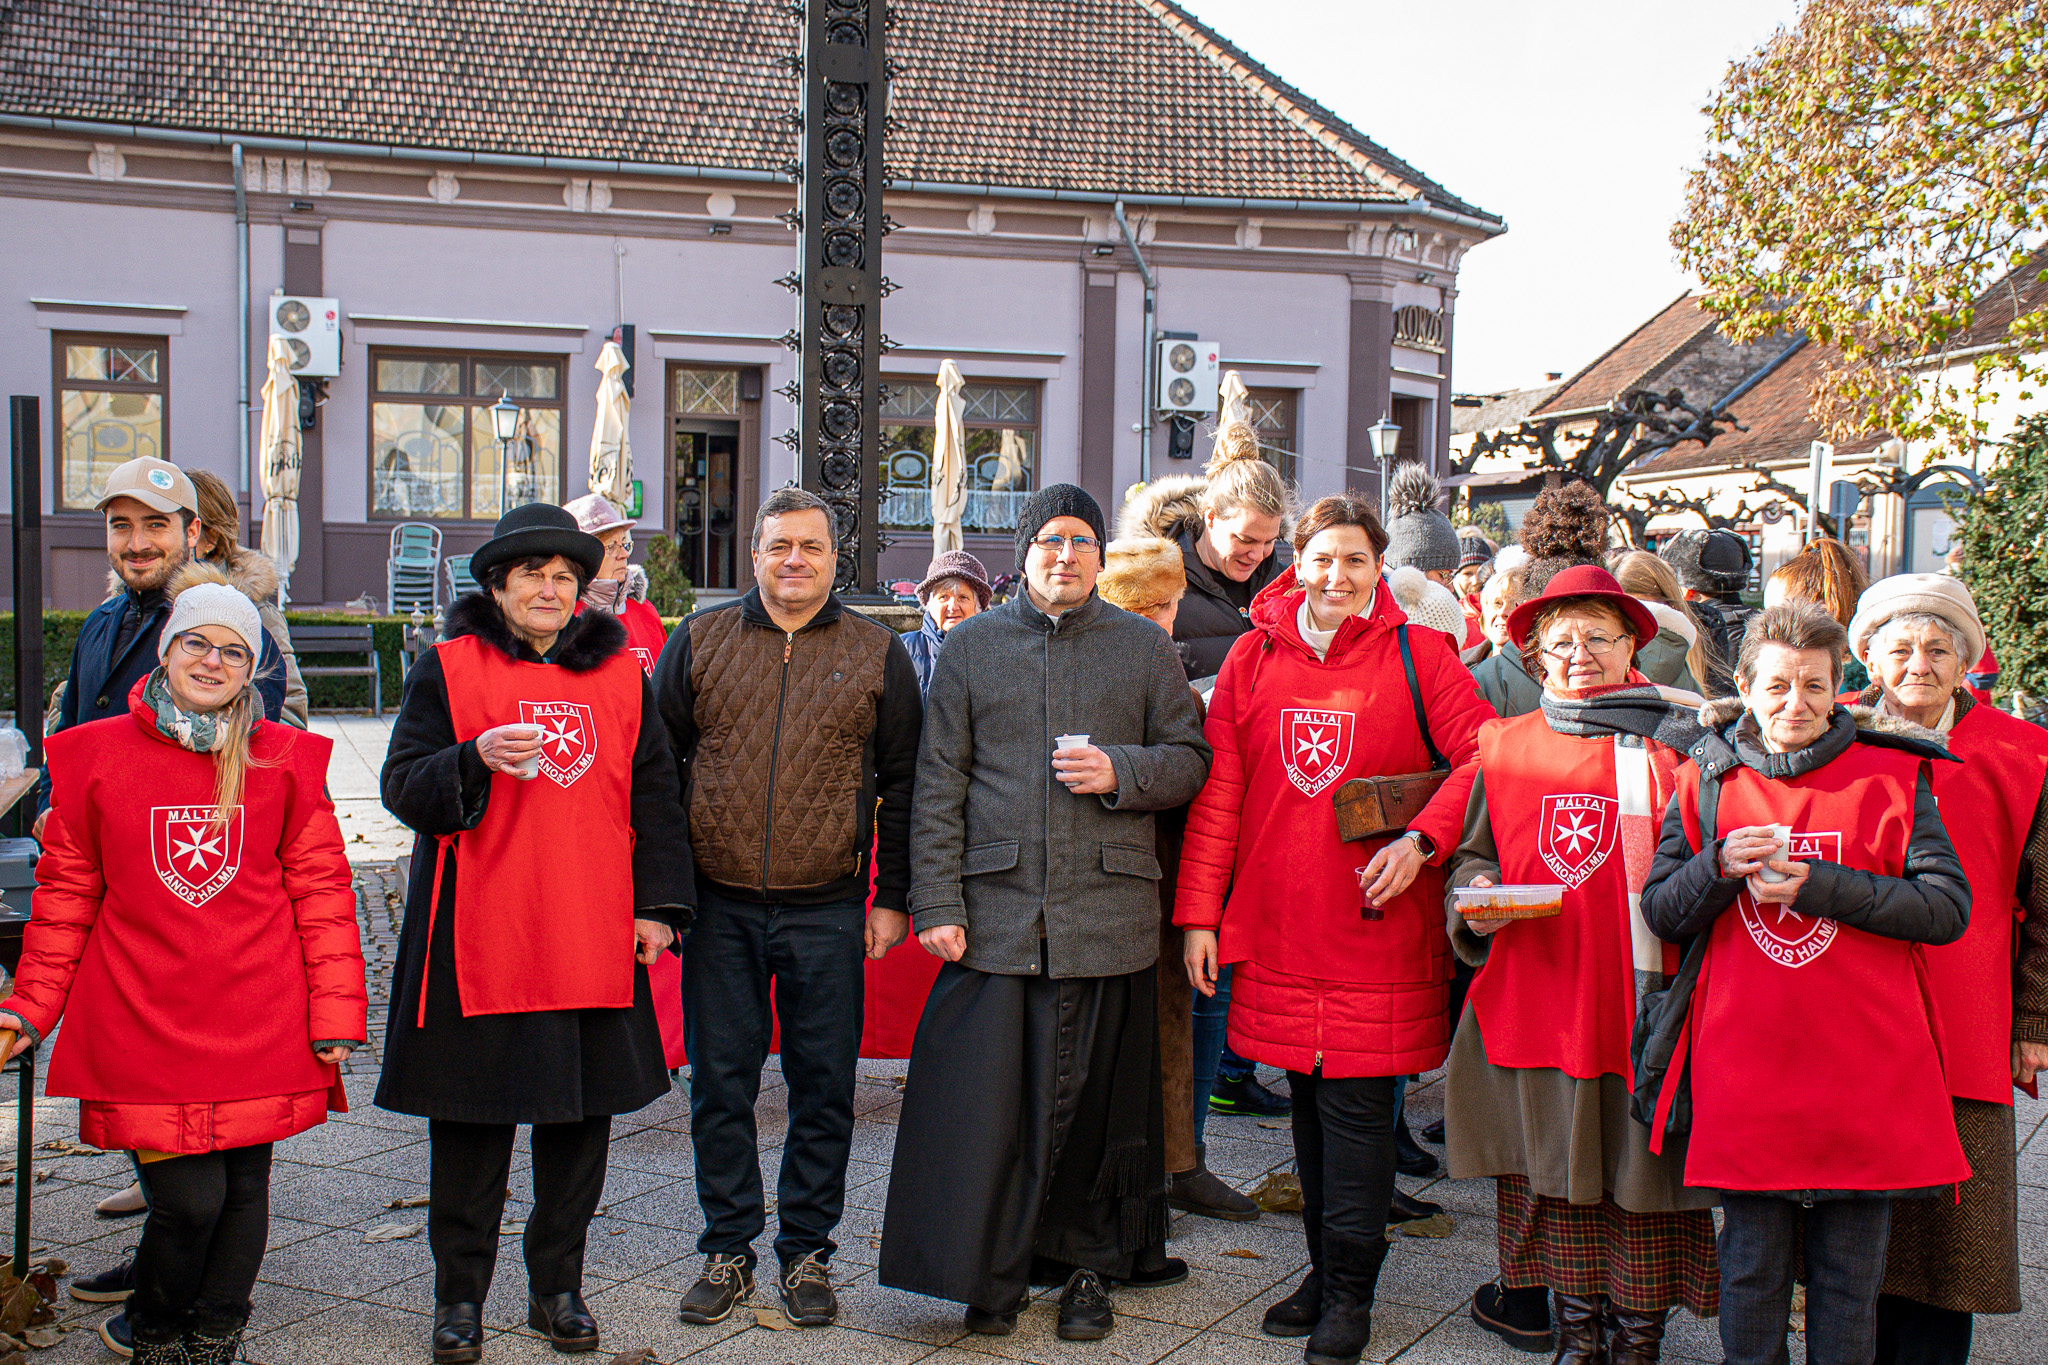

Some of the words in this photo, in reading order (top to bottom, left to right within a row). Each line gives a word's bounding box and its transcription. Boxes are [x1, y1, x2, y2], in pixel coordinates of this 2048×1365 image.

[1394, 305, 1444, 347] KORZÓ
[533, 704, 580, 715] MÁLTAI
[1293, 711, 1341, 724] MÁLTAI
[538, 753, 594, 783] ÁNOSHALMA
[1555, 795, 1606, 810] MÁLTAI
[1789, 838, 1820, 852] TAI
